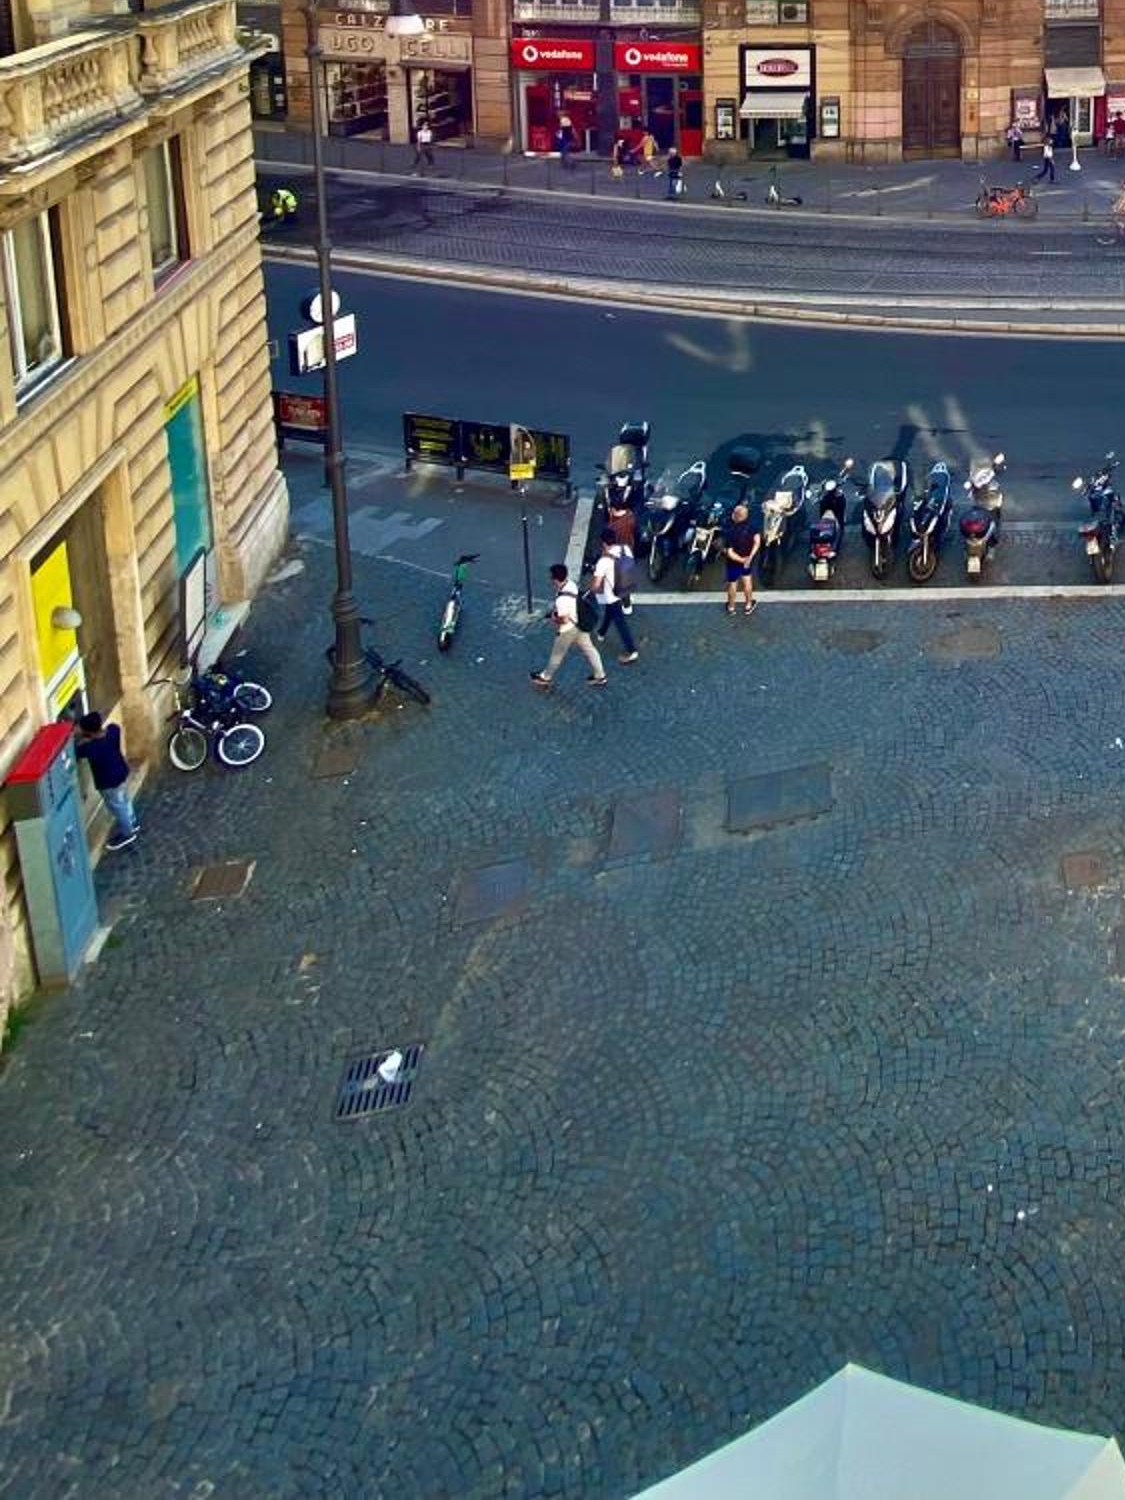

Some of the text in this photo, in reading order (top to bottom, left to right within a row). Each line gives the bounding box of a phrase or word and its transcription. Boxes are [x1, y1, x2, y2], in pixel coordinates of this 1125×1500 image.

[332, 36, 375, 52] UGO
[539, 49, 583, 60] vodafone
[642, 50, 689, 62] vodafone
